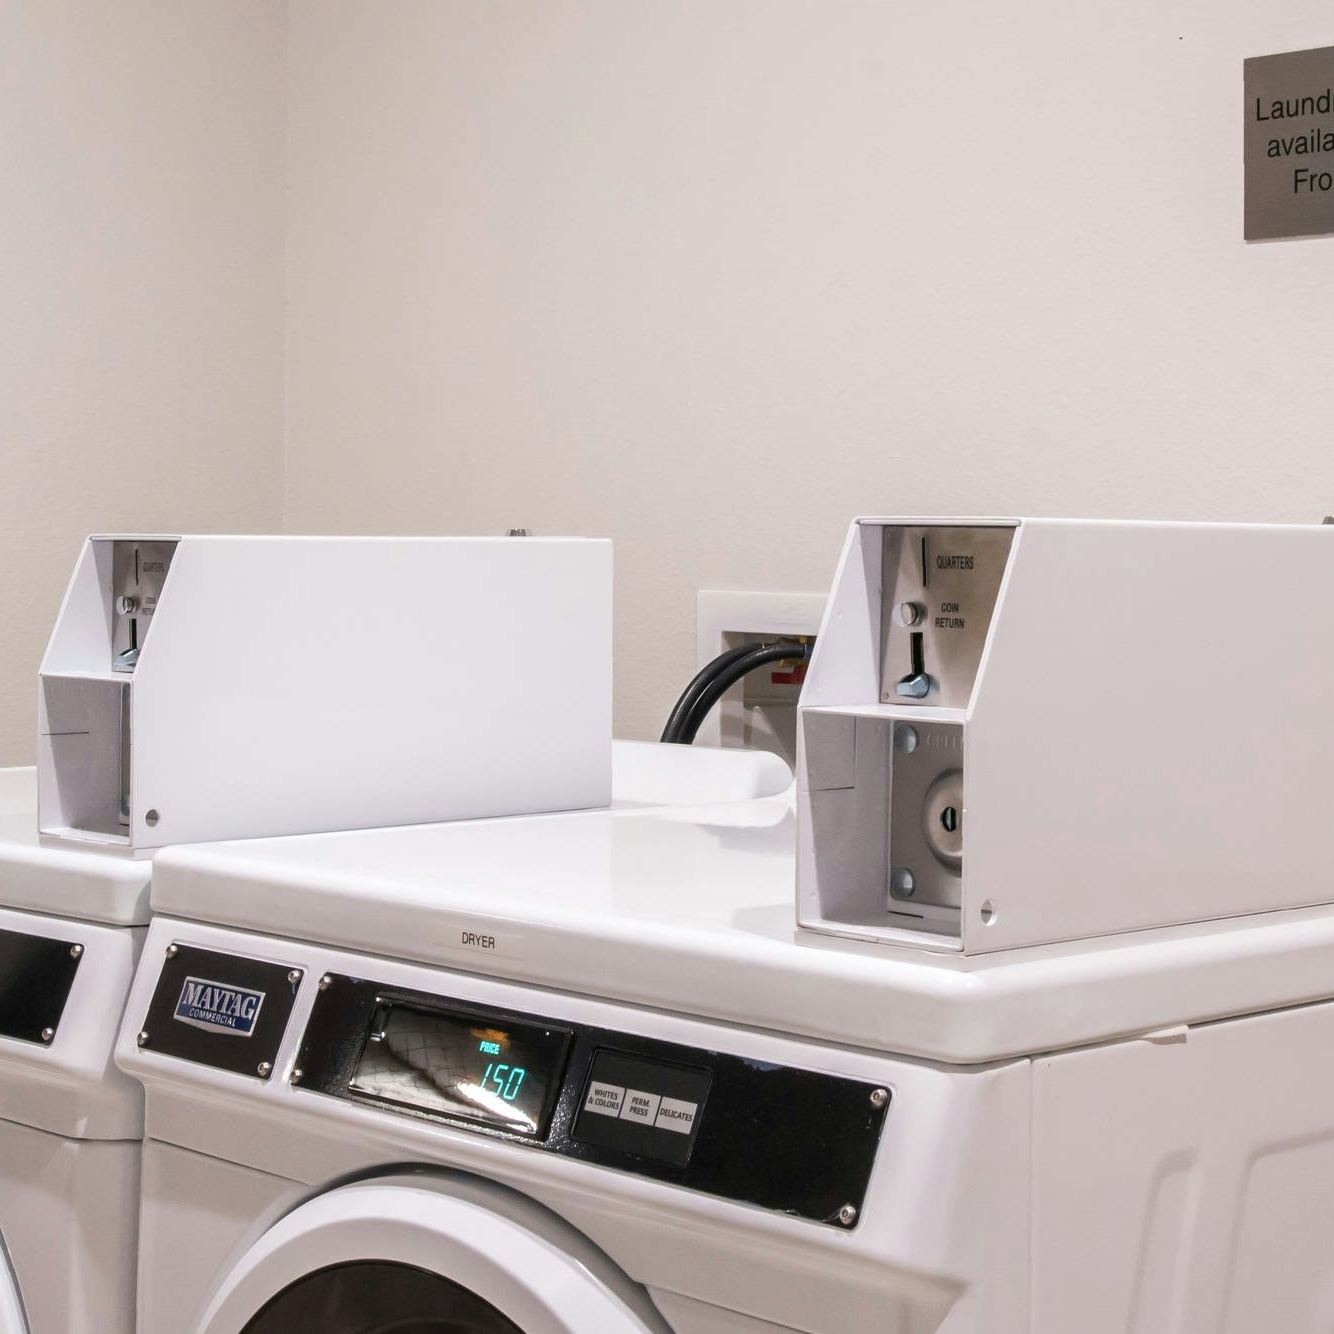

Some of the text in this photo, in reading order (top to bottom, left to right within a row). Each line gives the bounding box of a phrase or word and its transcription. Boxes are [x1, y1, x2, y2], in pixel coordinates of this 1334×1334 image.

[936, 555, 974, 569] QUARTERS
[941, 603, 959, 612] COIN
[935, 617, 964, 628] RETURN
[461, 931, 496, 949] DRYER
[181, 982, 257, 1020] MAYTAG
[189, 1007, 236, 1027] COMMERCIAL
[479, 1040, 501, 1055] PRICE
[594, 1089, 618, 1100] WHITES
[595, 1098, 619, 1110] COLORS
[629, 1106, 648, 1116] PRESS
[660, 1108, 693, 1121] DELICATES
